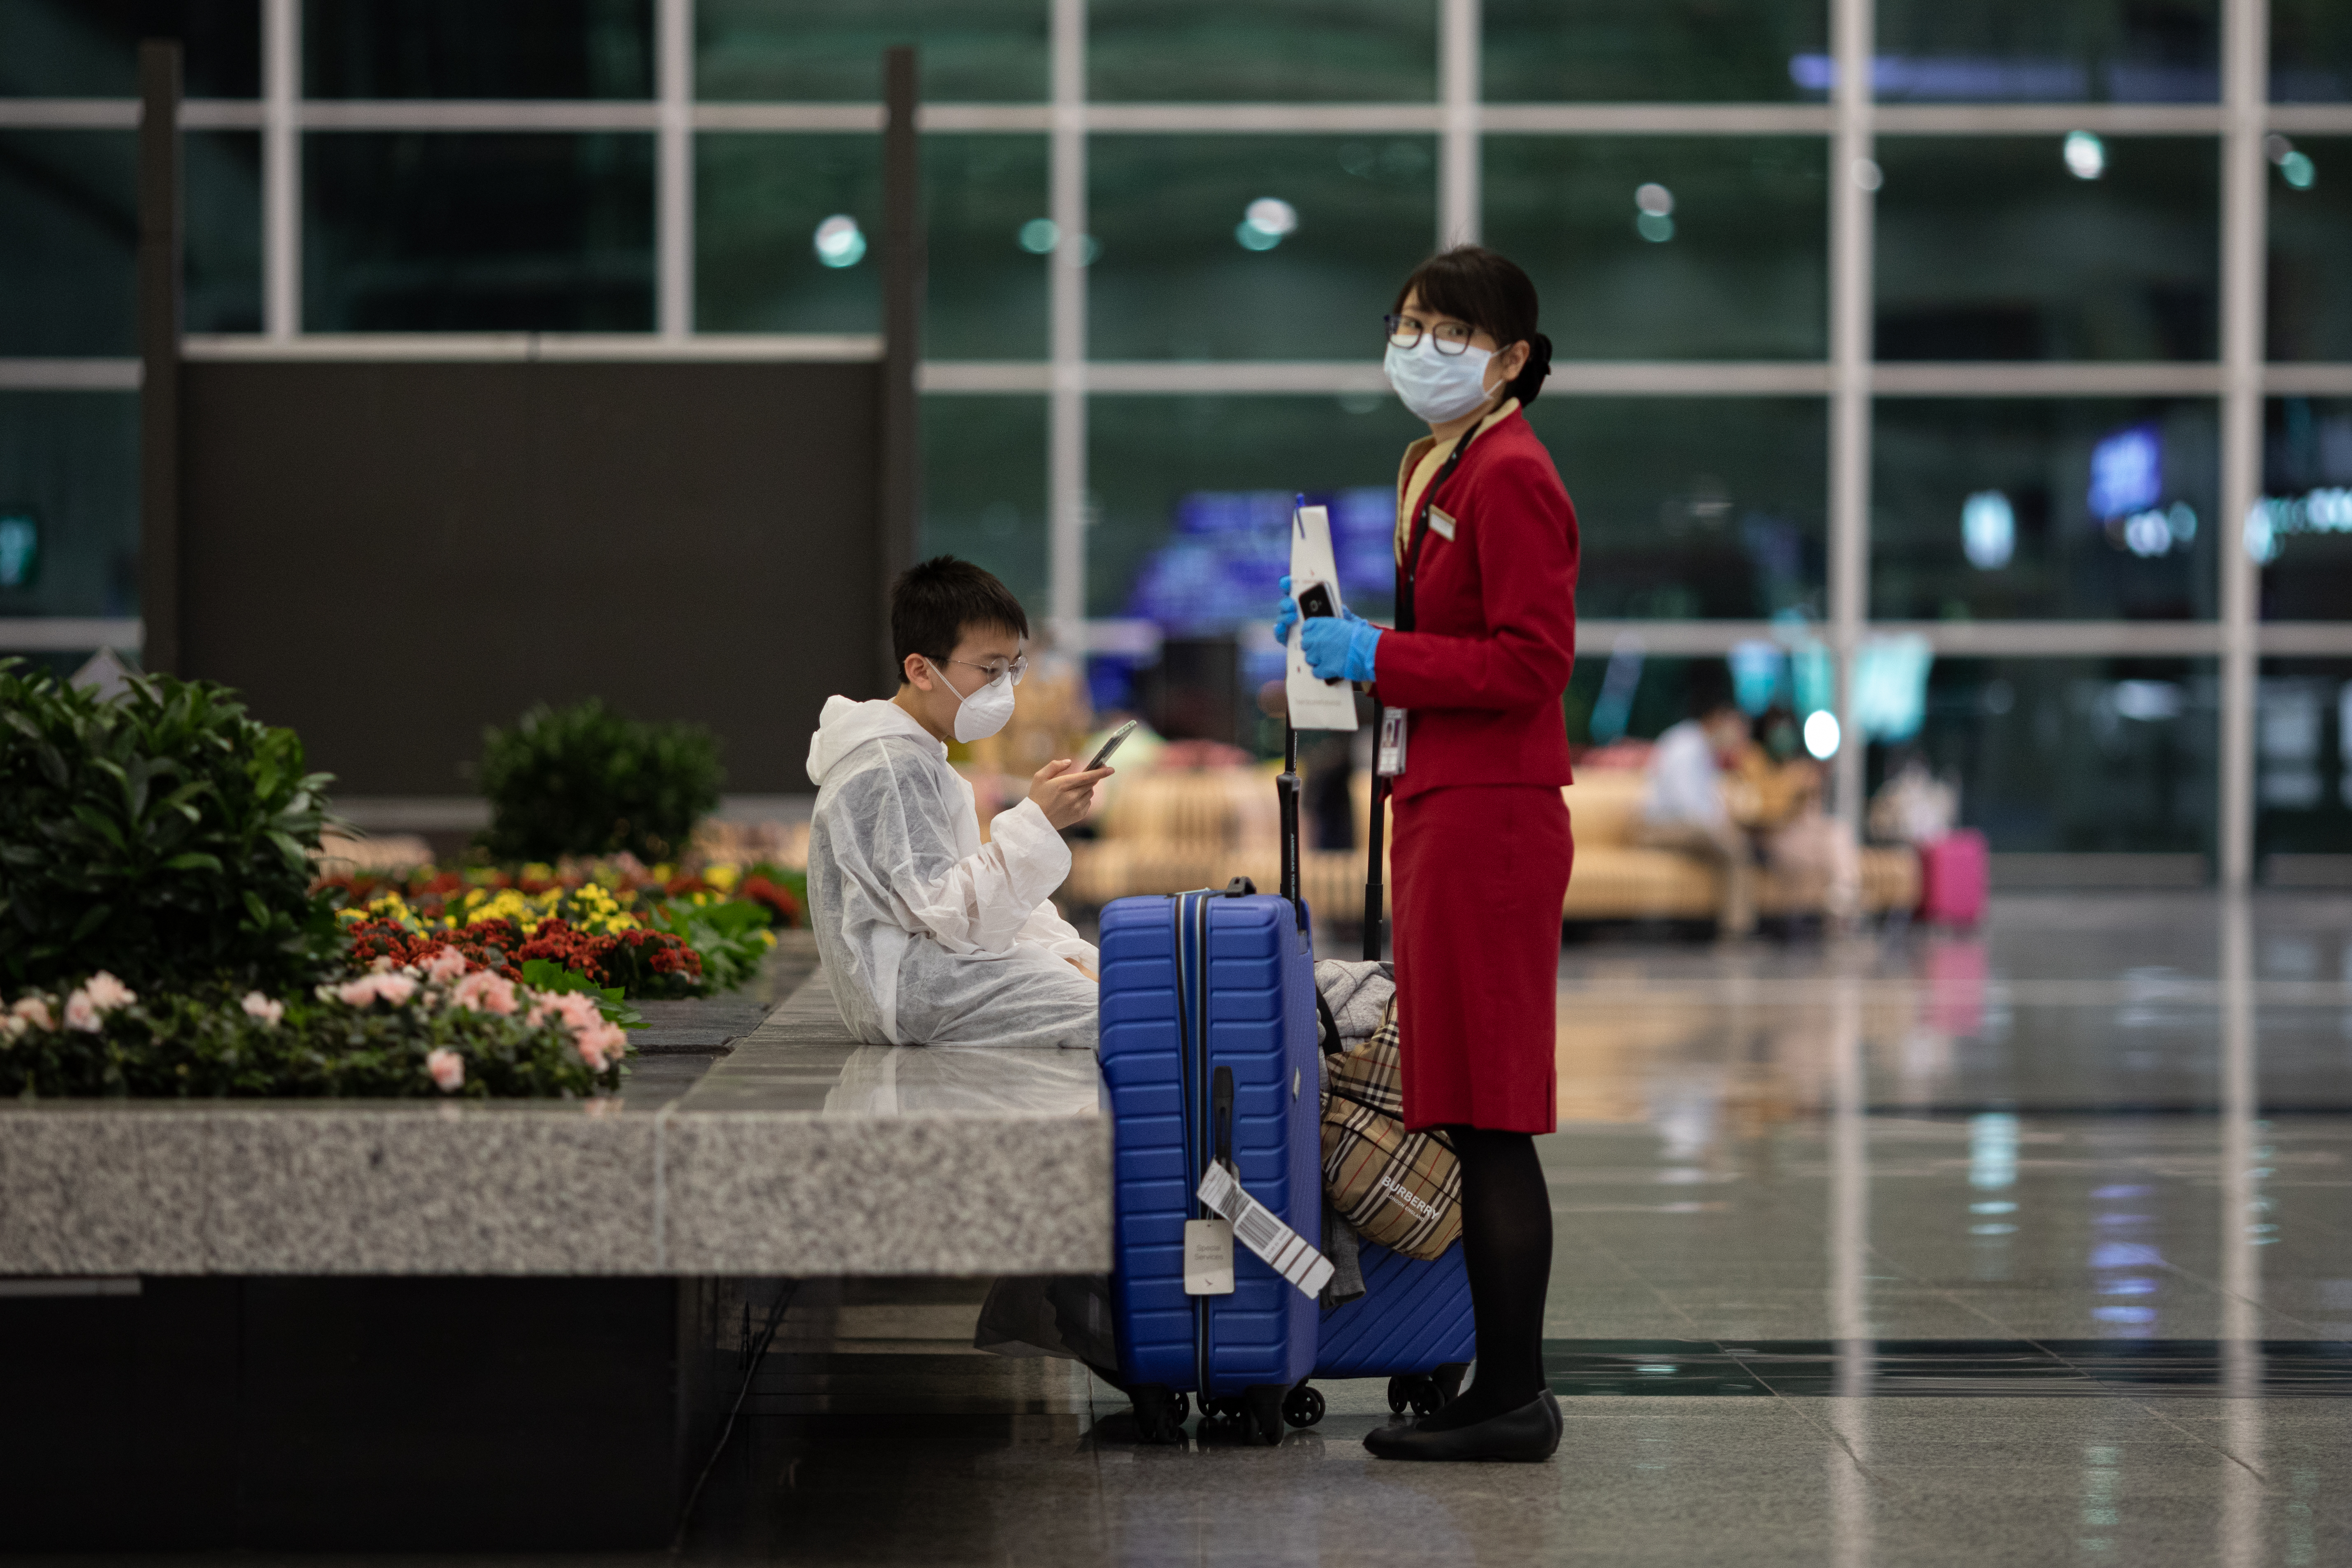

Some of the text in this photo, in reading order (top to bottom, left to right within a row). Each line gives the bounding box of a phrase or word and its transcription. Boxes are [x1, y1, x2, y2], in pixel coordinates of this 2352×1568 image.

[1381, 1175, 1440, 1220] BURBERRY
[1387, 1194, 1425, 1222] LONDON ENGLAND
